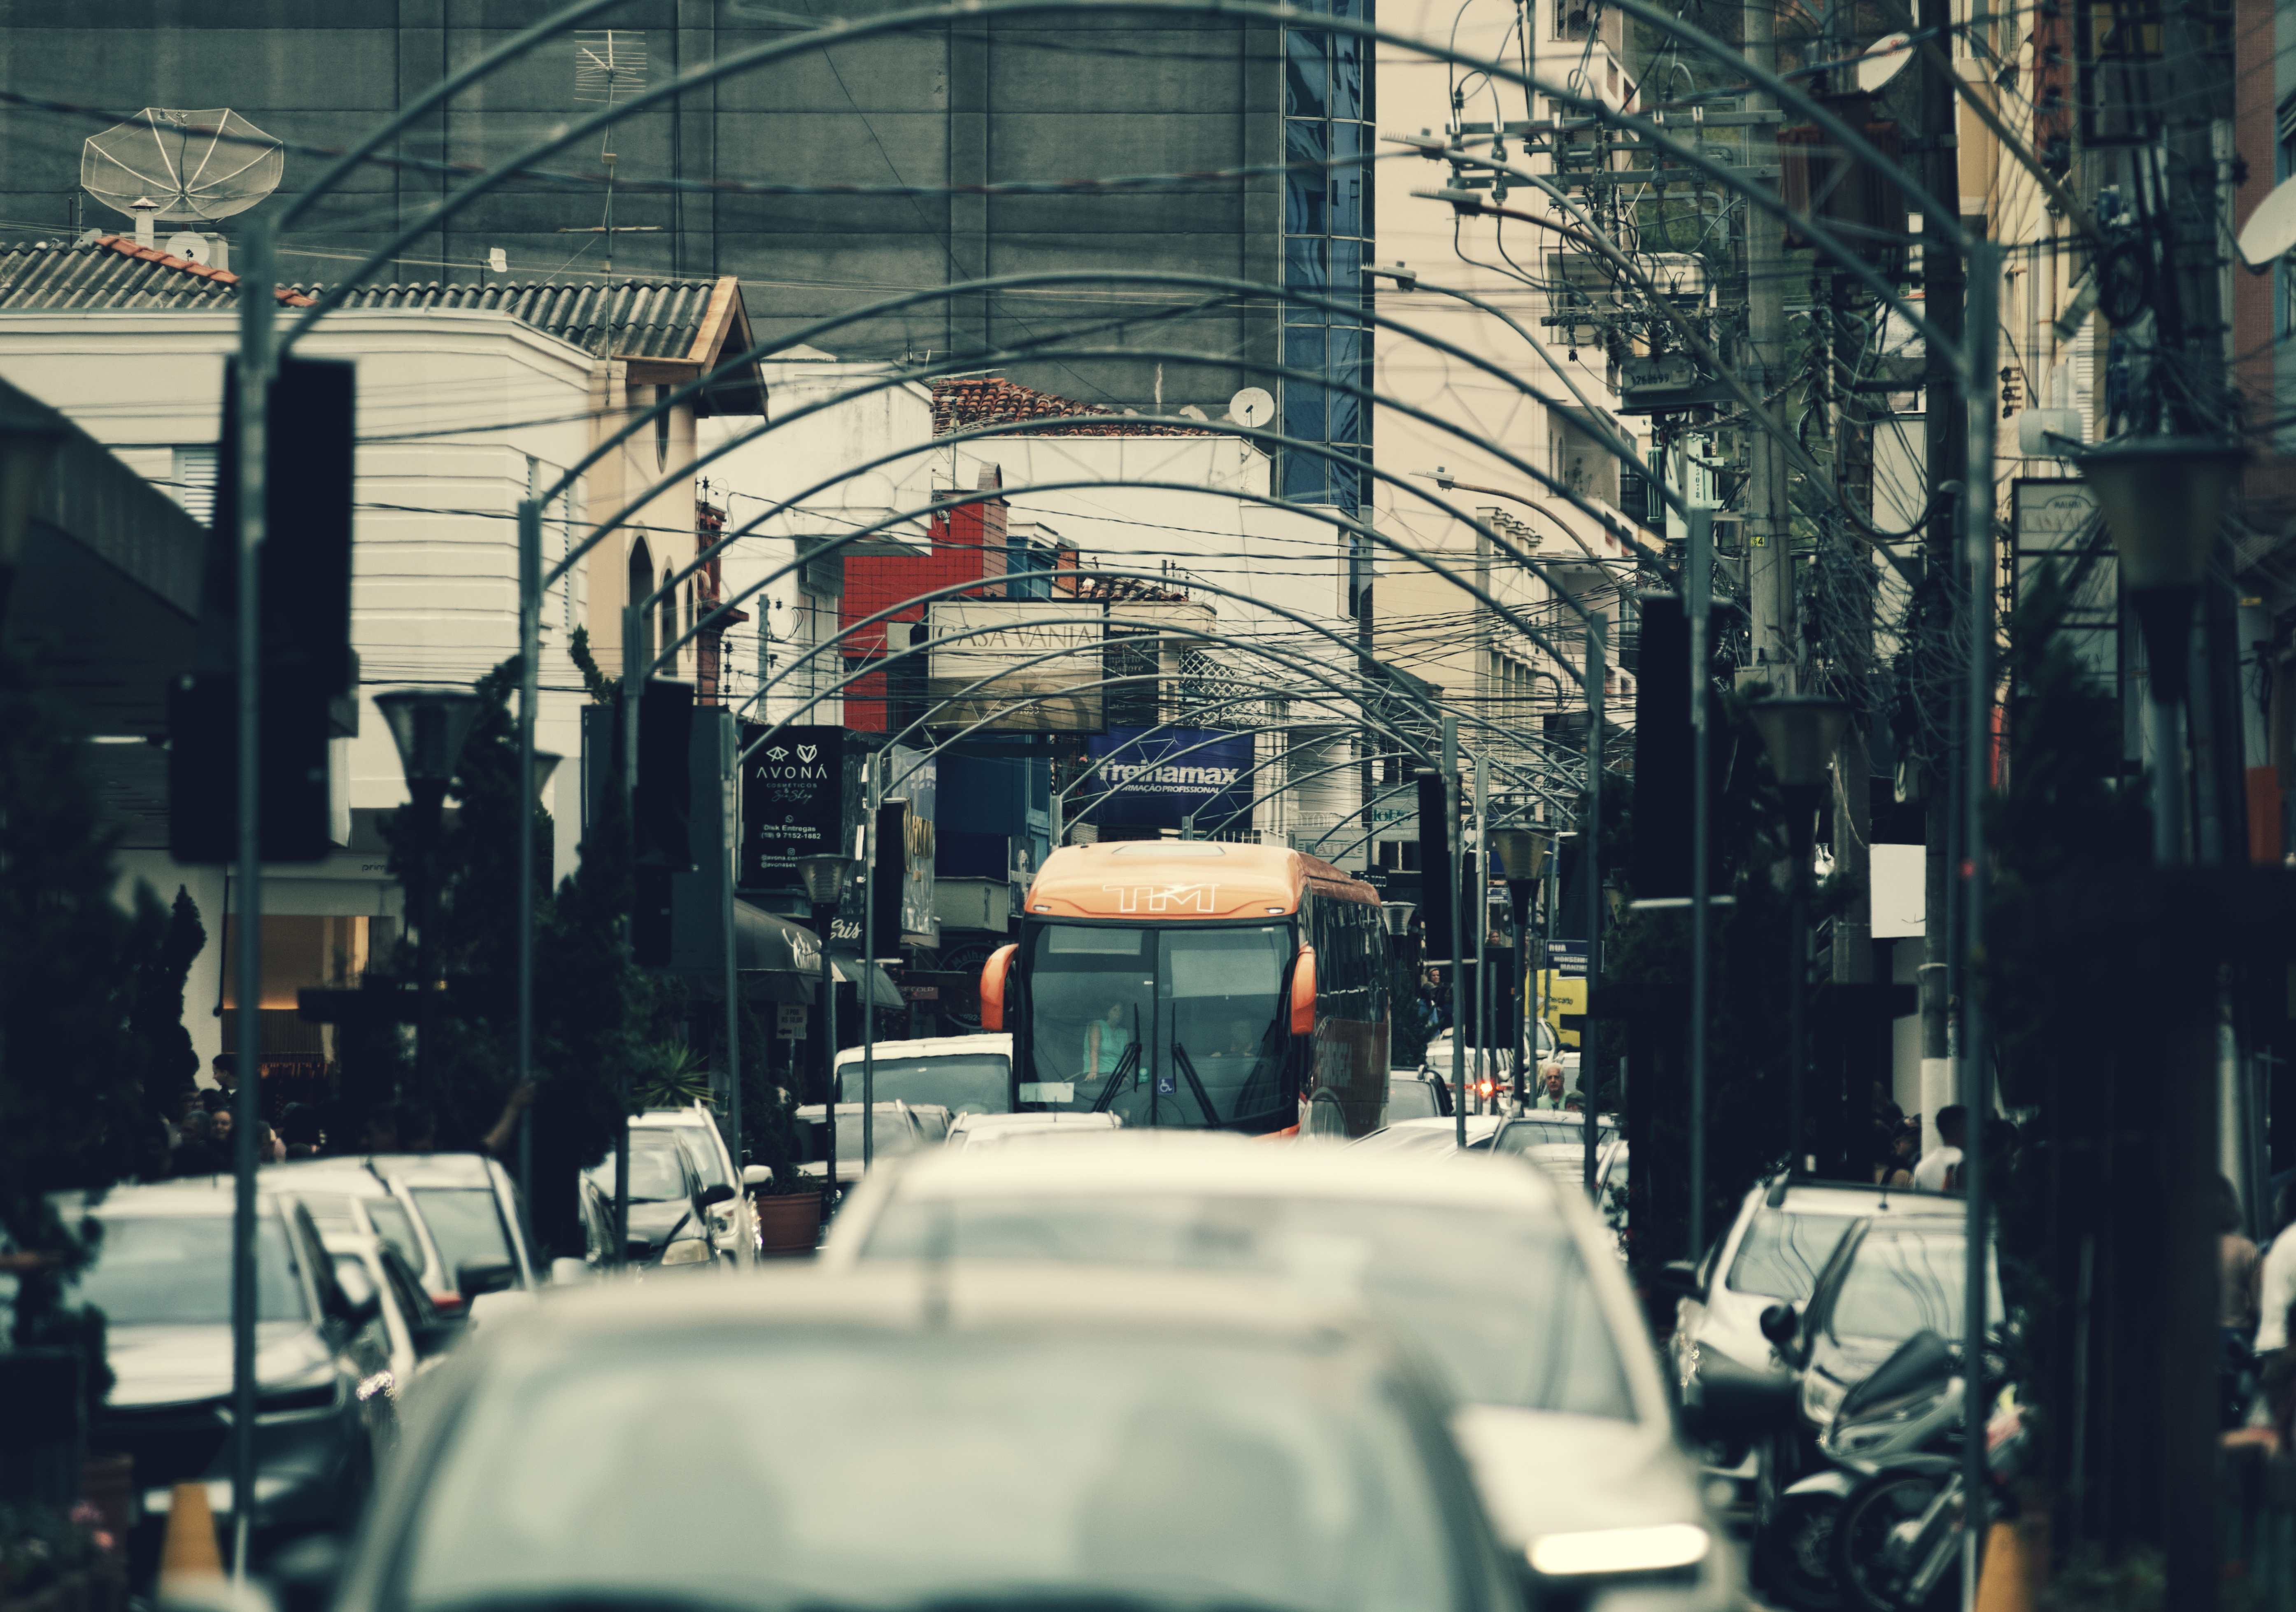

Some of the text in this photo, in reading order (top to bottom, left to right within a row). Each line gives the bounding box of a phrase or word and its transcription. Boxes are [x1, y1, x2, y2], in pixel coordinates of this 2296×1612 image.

[938, 623, 1092, 648] CASA VANIA
[757, 764, 827, 779] AVONÁ
[1549, 943, 1567, 953] RUA
